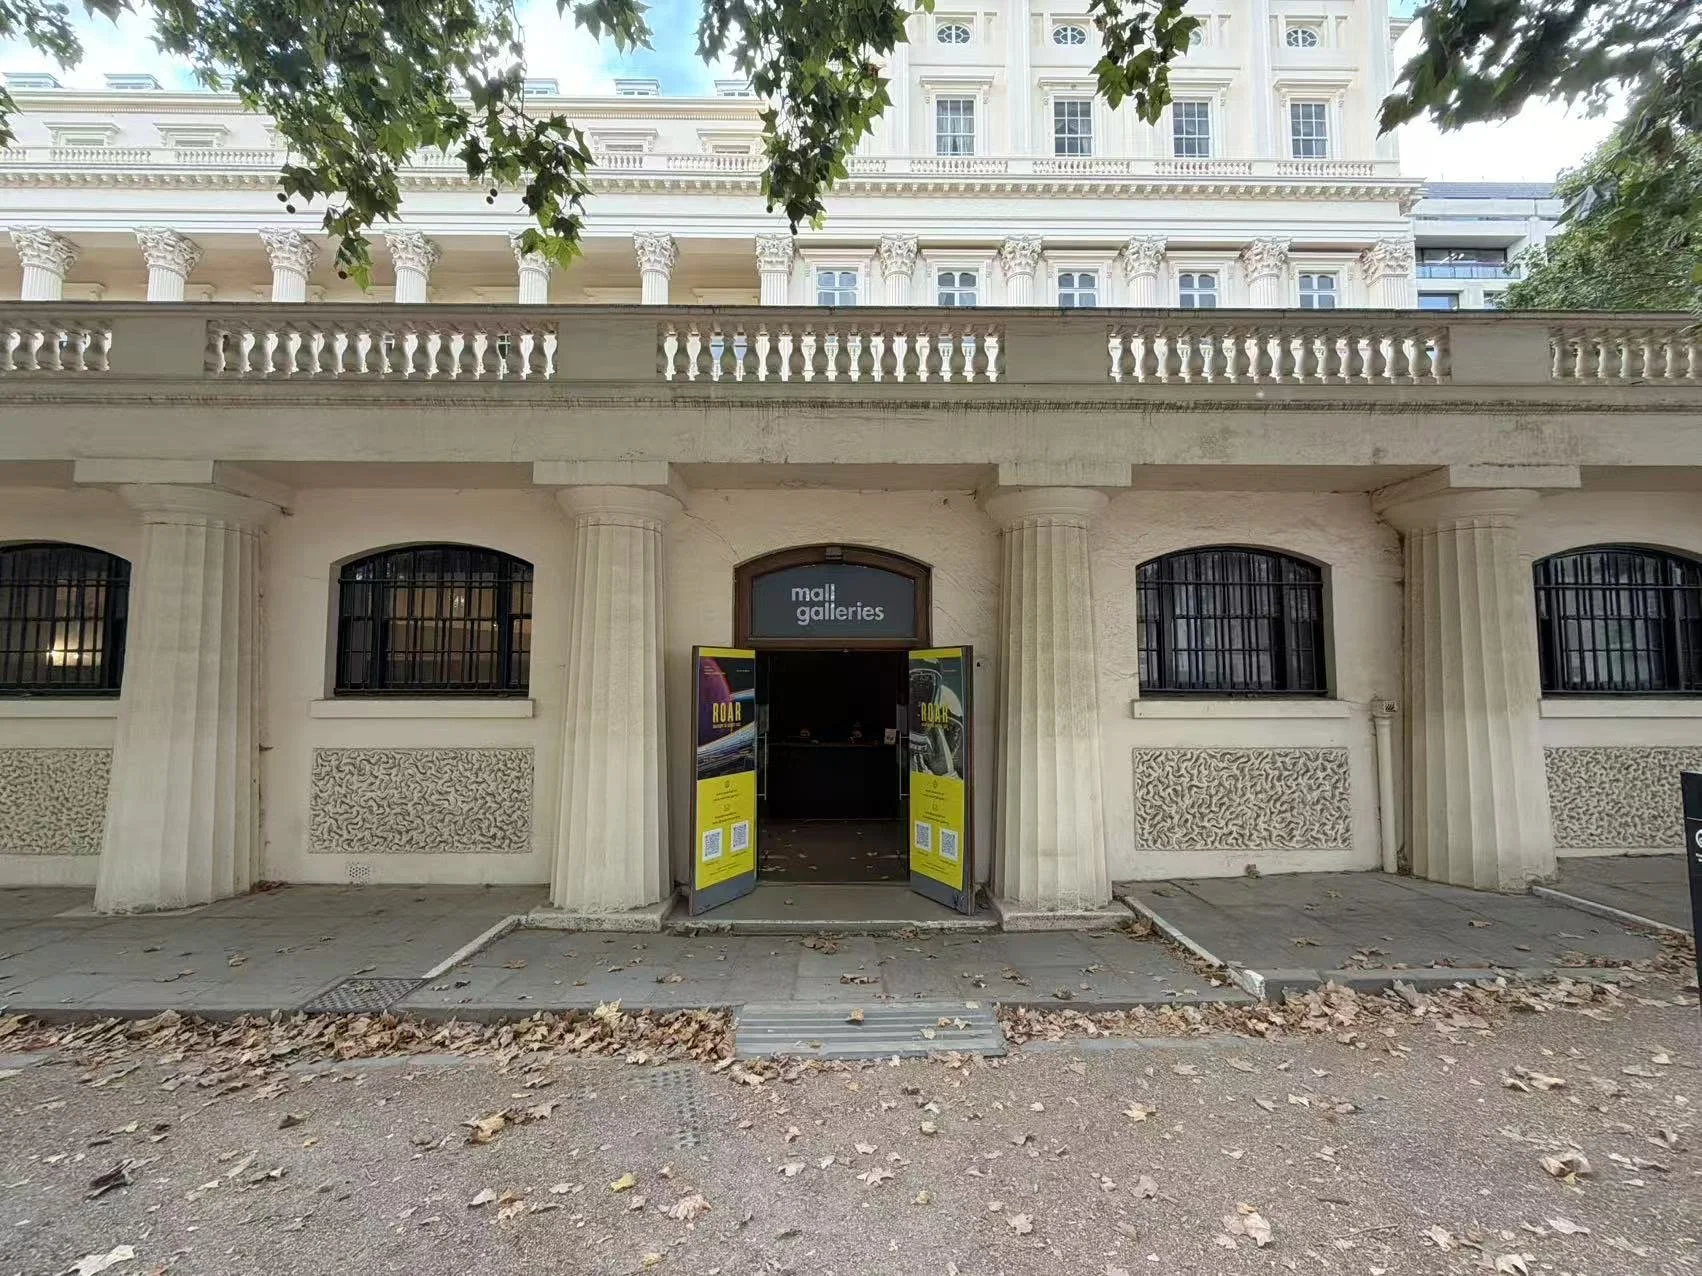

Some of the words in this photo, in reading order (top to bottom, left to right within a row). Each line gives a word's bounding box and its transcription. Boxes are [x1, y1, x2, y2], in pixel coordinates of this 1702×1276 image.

[791, 583, 835, 601] mall
[796, 601, 885, 626] galleries
[712, 702, 741, 723] ROAR
[921, 702, 948, 723] ROAR
